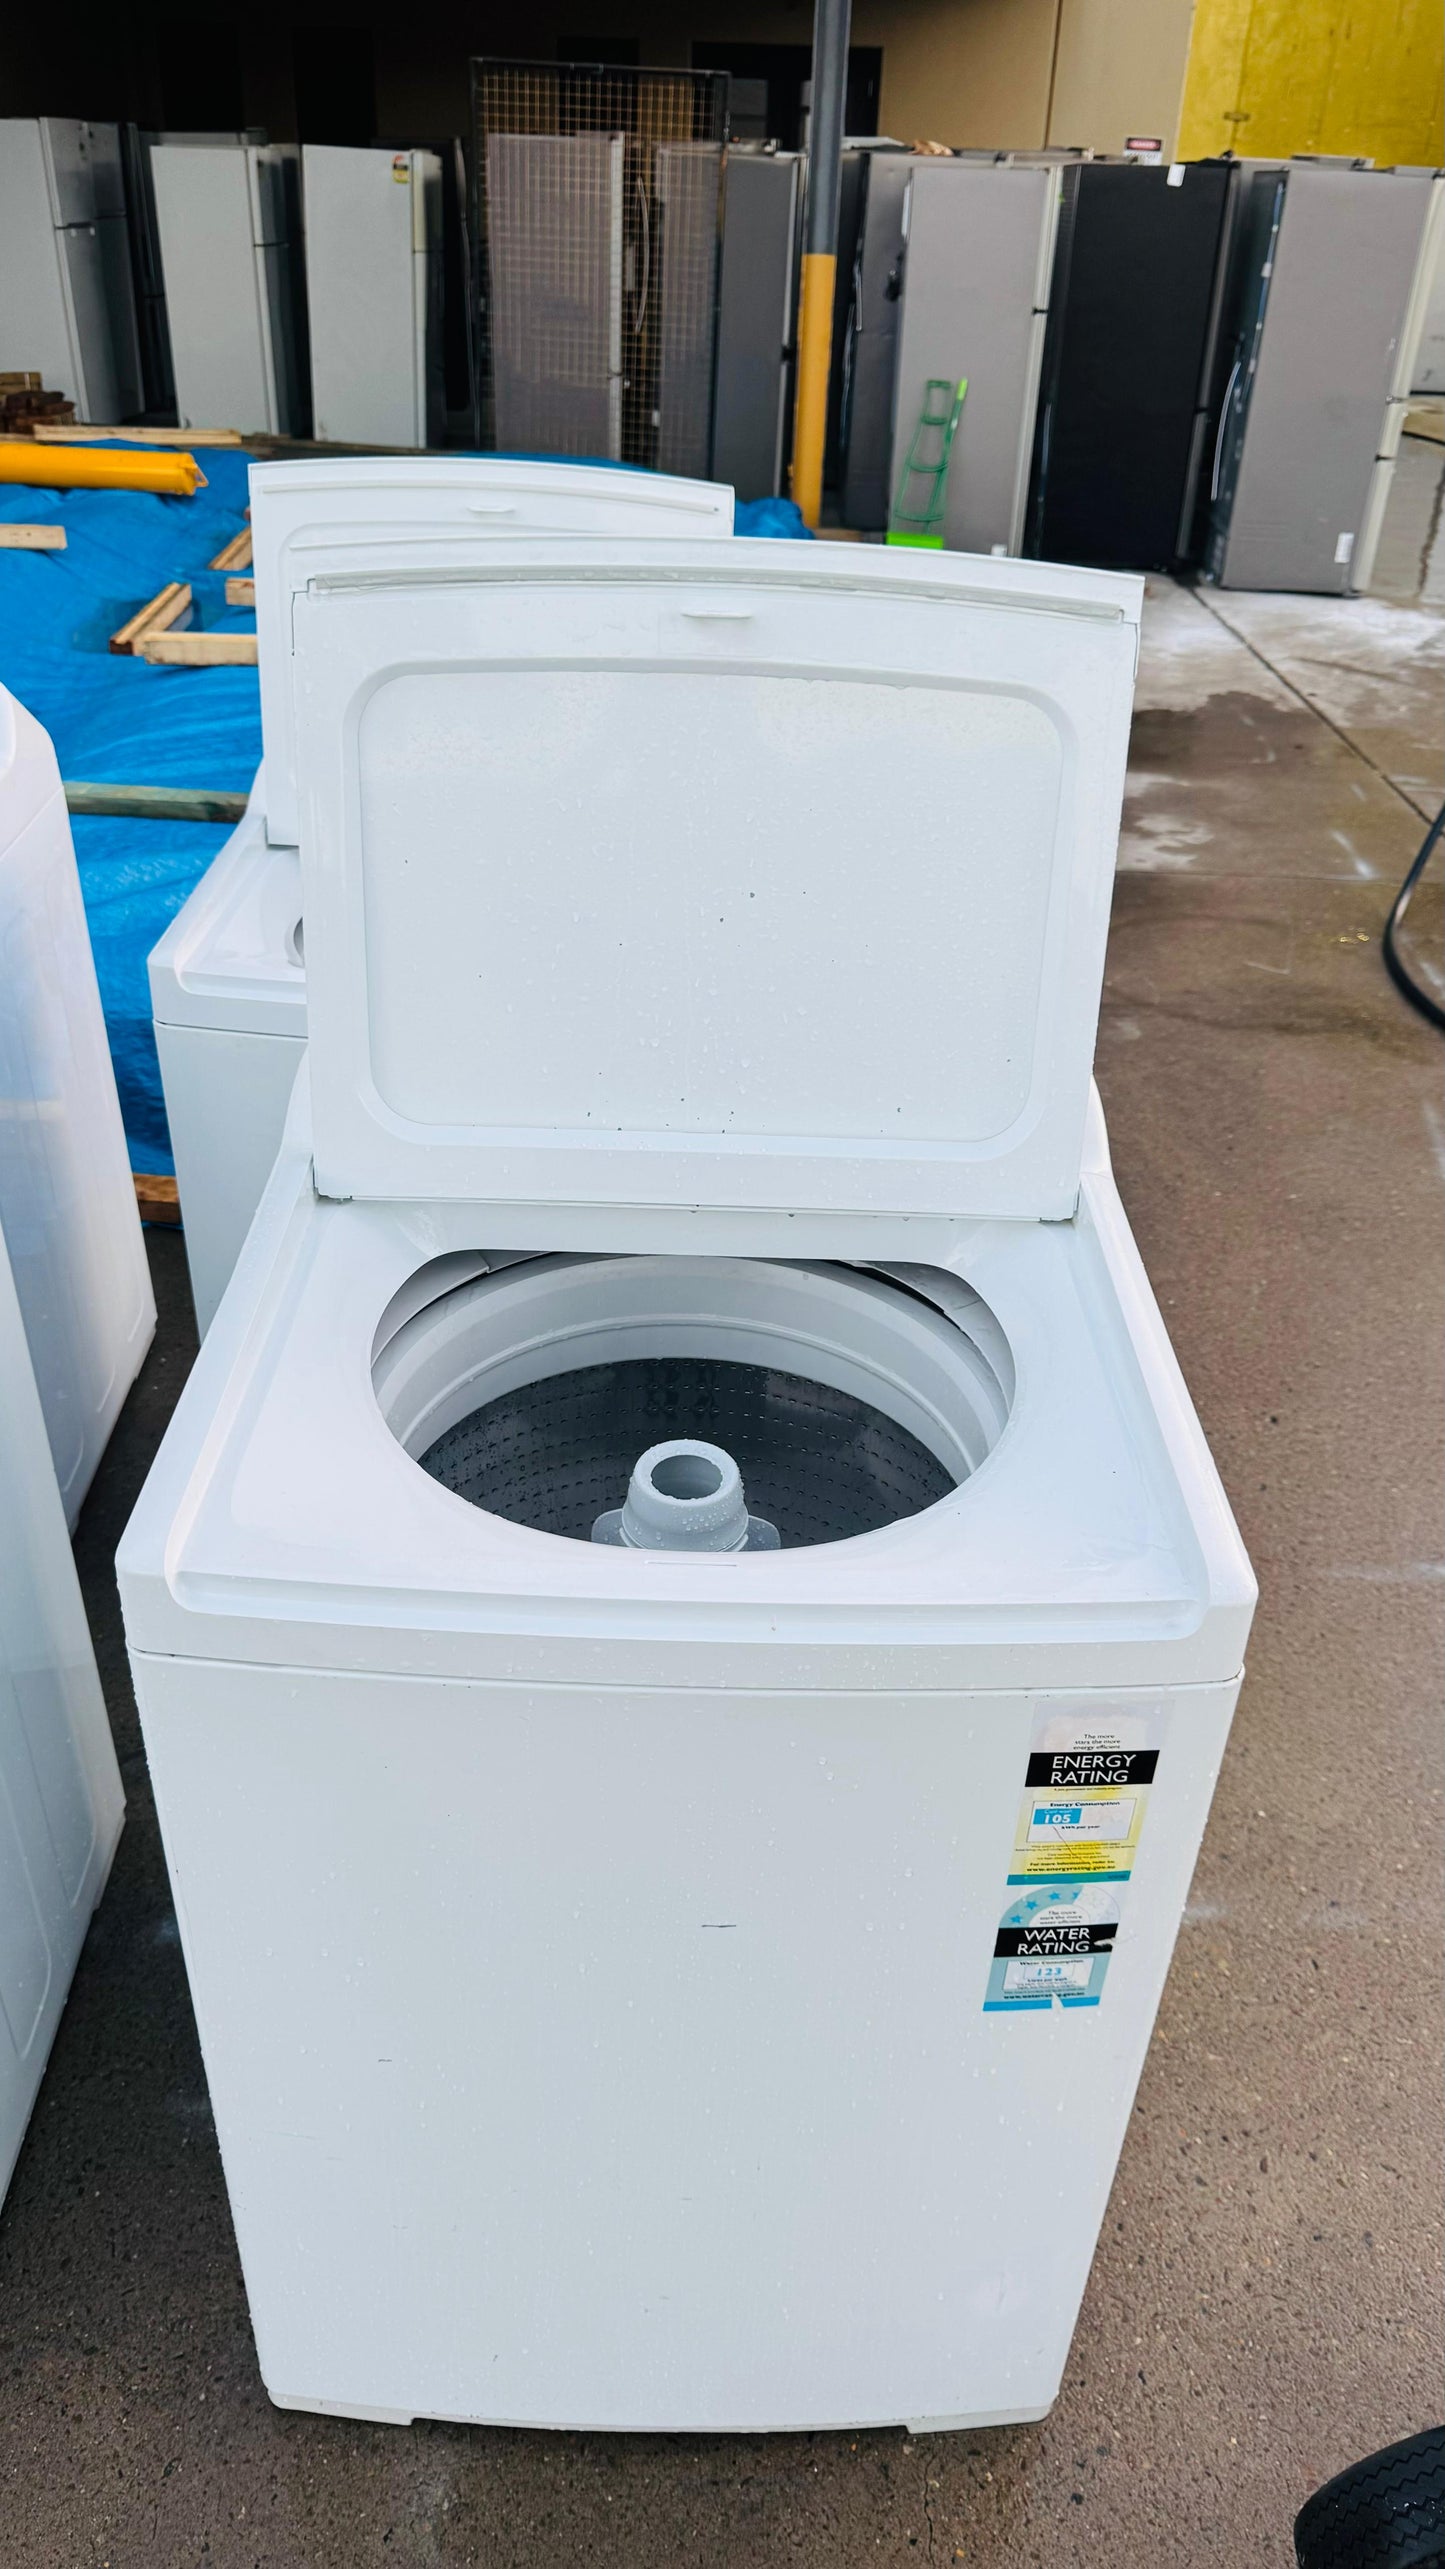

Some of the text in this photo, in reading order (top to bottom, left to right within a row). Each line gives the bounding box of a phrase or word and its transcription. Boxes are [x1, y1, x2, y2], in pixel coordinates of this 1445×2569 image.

[1052, 1754, 1137, 1769] ENERGY
[1050, 1769, 1129, 1784] RATING
[1044, 1814, 1071, 1824] 105
[1024, 1927, 1091, 1942] WATER
[1017, 1940, 1090, 1955] RATING
[1037, 1967, 1062, 1977] 123
